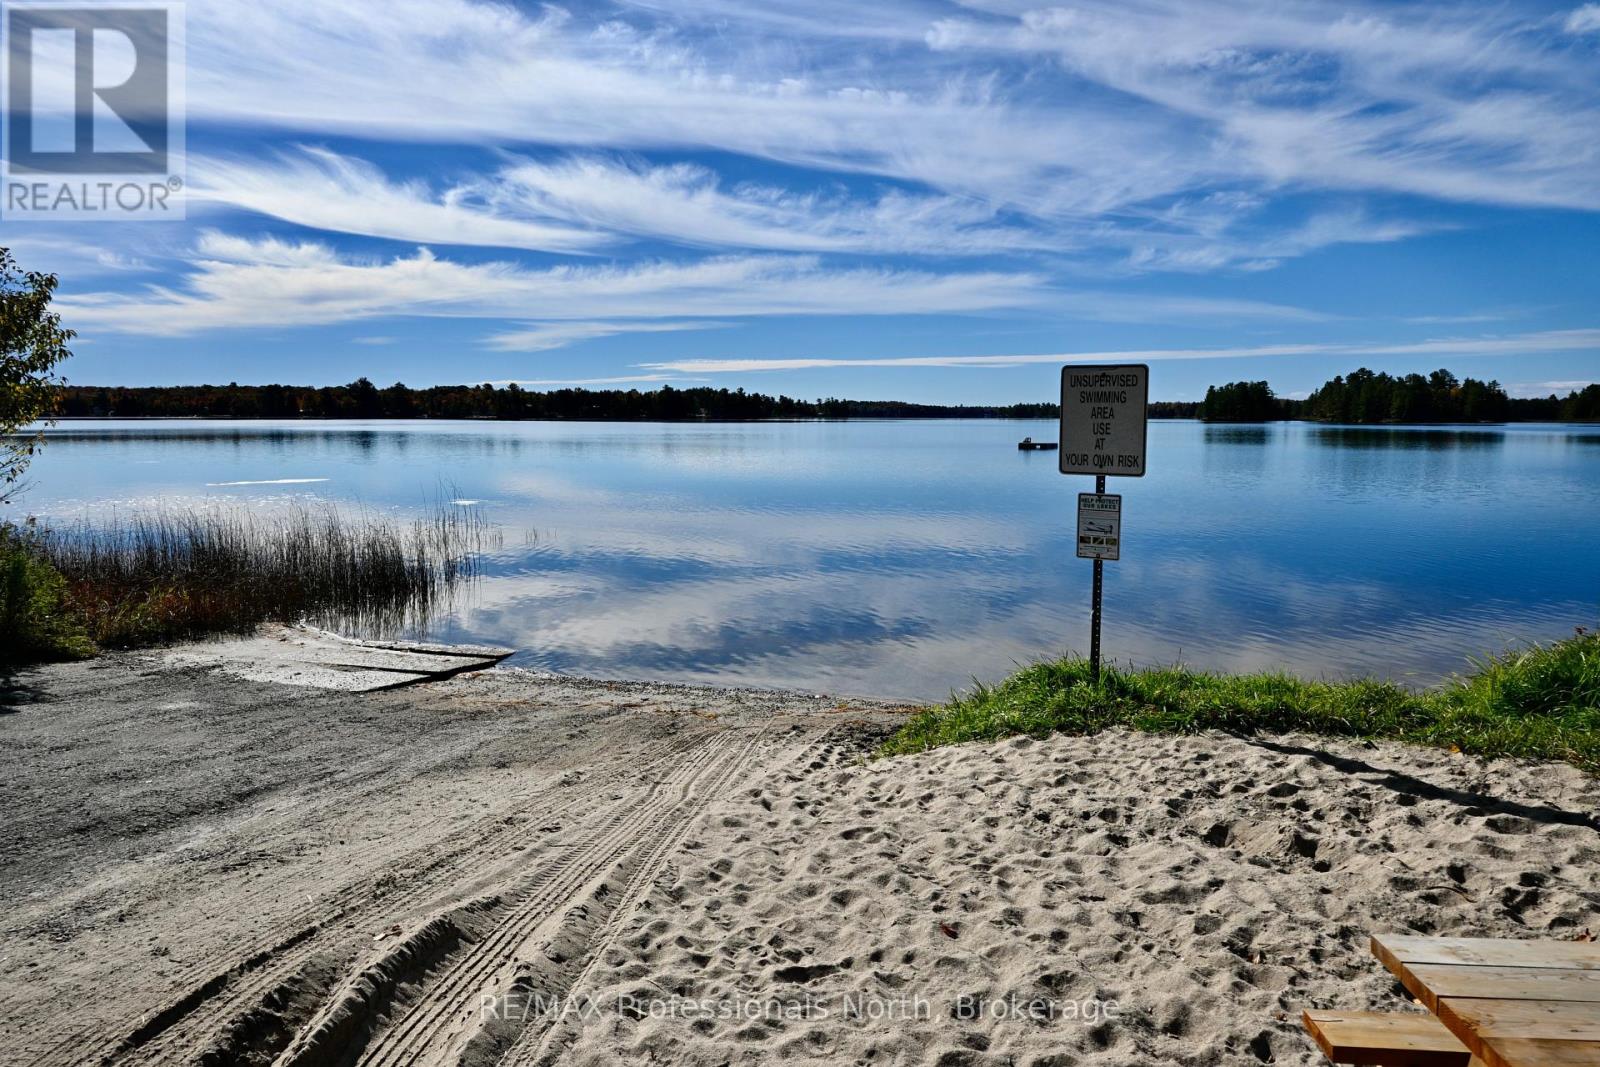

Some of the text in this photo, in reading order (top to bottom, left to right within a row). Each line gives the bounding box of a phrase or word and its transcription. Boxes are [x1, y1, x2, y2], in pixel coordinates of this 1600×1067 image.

[1070, 374, 1138, 388] UNSUPERVISED
[1080, 390, 1127, 404] SWIMMING
[1091, 406, 1115, 420] AREA
[1093, 422, 1111, 435] USE
[1094, 438, 1106, 450] AT
[1065, 453, 1140, 468] YOUR OWN RISK
